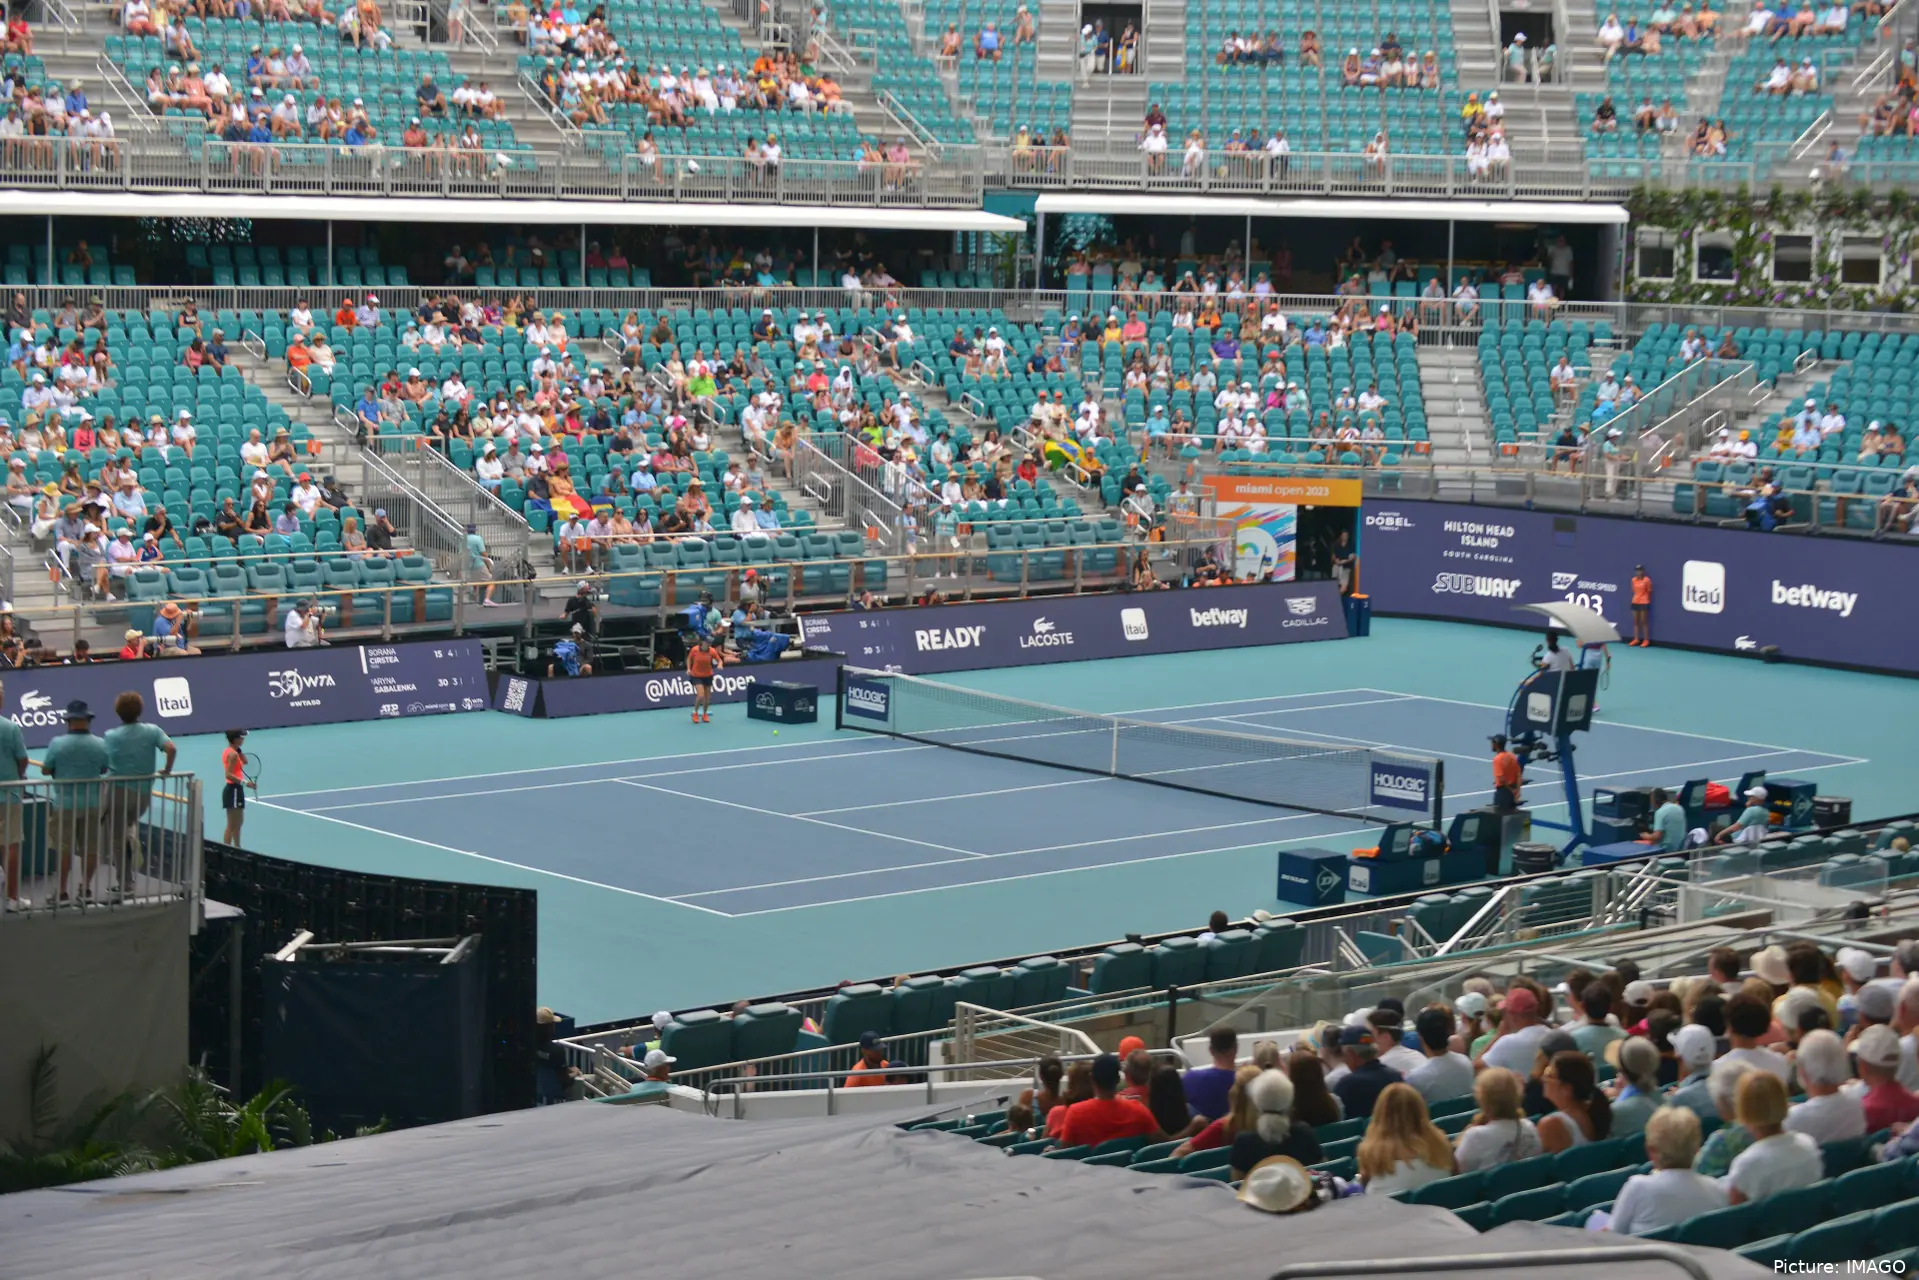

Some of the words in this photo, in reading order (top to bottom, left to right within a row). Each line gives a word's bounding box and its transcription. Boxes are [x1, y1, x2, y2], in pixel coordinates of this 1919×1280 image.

[1235, 483, 1272, 494] miami
[1274, 486, 1304, 496] open
[1306, 486, 1330, 496] 2023
[1366, 516, 1412, 527] DOBEL
[1444, 520, 1484, 534] HILTON
[1486, 524, 1515, 537] HEAD
[1461, 534, 1499, 548] ISLAND
[1443, 550, 1471, 558] SOUTH
[1474, 553, 1514, 563] CAROLINA
[1431, 572, 1522, 599] SUBWAY
[1686, 585, 1721, 605] Itaú
[1772, 579, 1858, 617] betway
[1190, 607, 1248, 628] betway
[1281, 616, 1328, 628] CADILLAC
[1125, 623, 1146, 636] Itaú
[915, 625, 982, 651] READY
[1020, 632, 1074, 648] LACOSTE
[368, 648, 396, 656] SORANA
[434, 650, 443, 658] 15
[448, 649, 453, 657] 4
[369, 655, 400, 664] CIRSTEA
[302, 674, 336, 688] WTA
[438, 678, 448, 687] 30
[452, 677, 458, 686] 3
[374, 684, 417, 693] SABALENKA
[848, 686, 887, 704] HOLOGIC
[159, 696, 189, 711] Itaú
[1374, 772, 1426, 792] HOLOGIC
